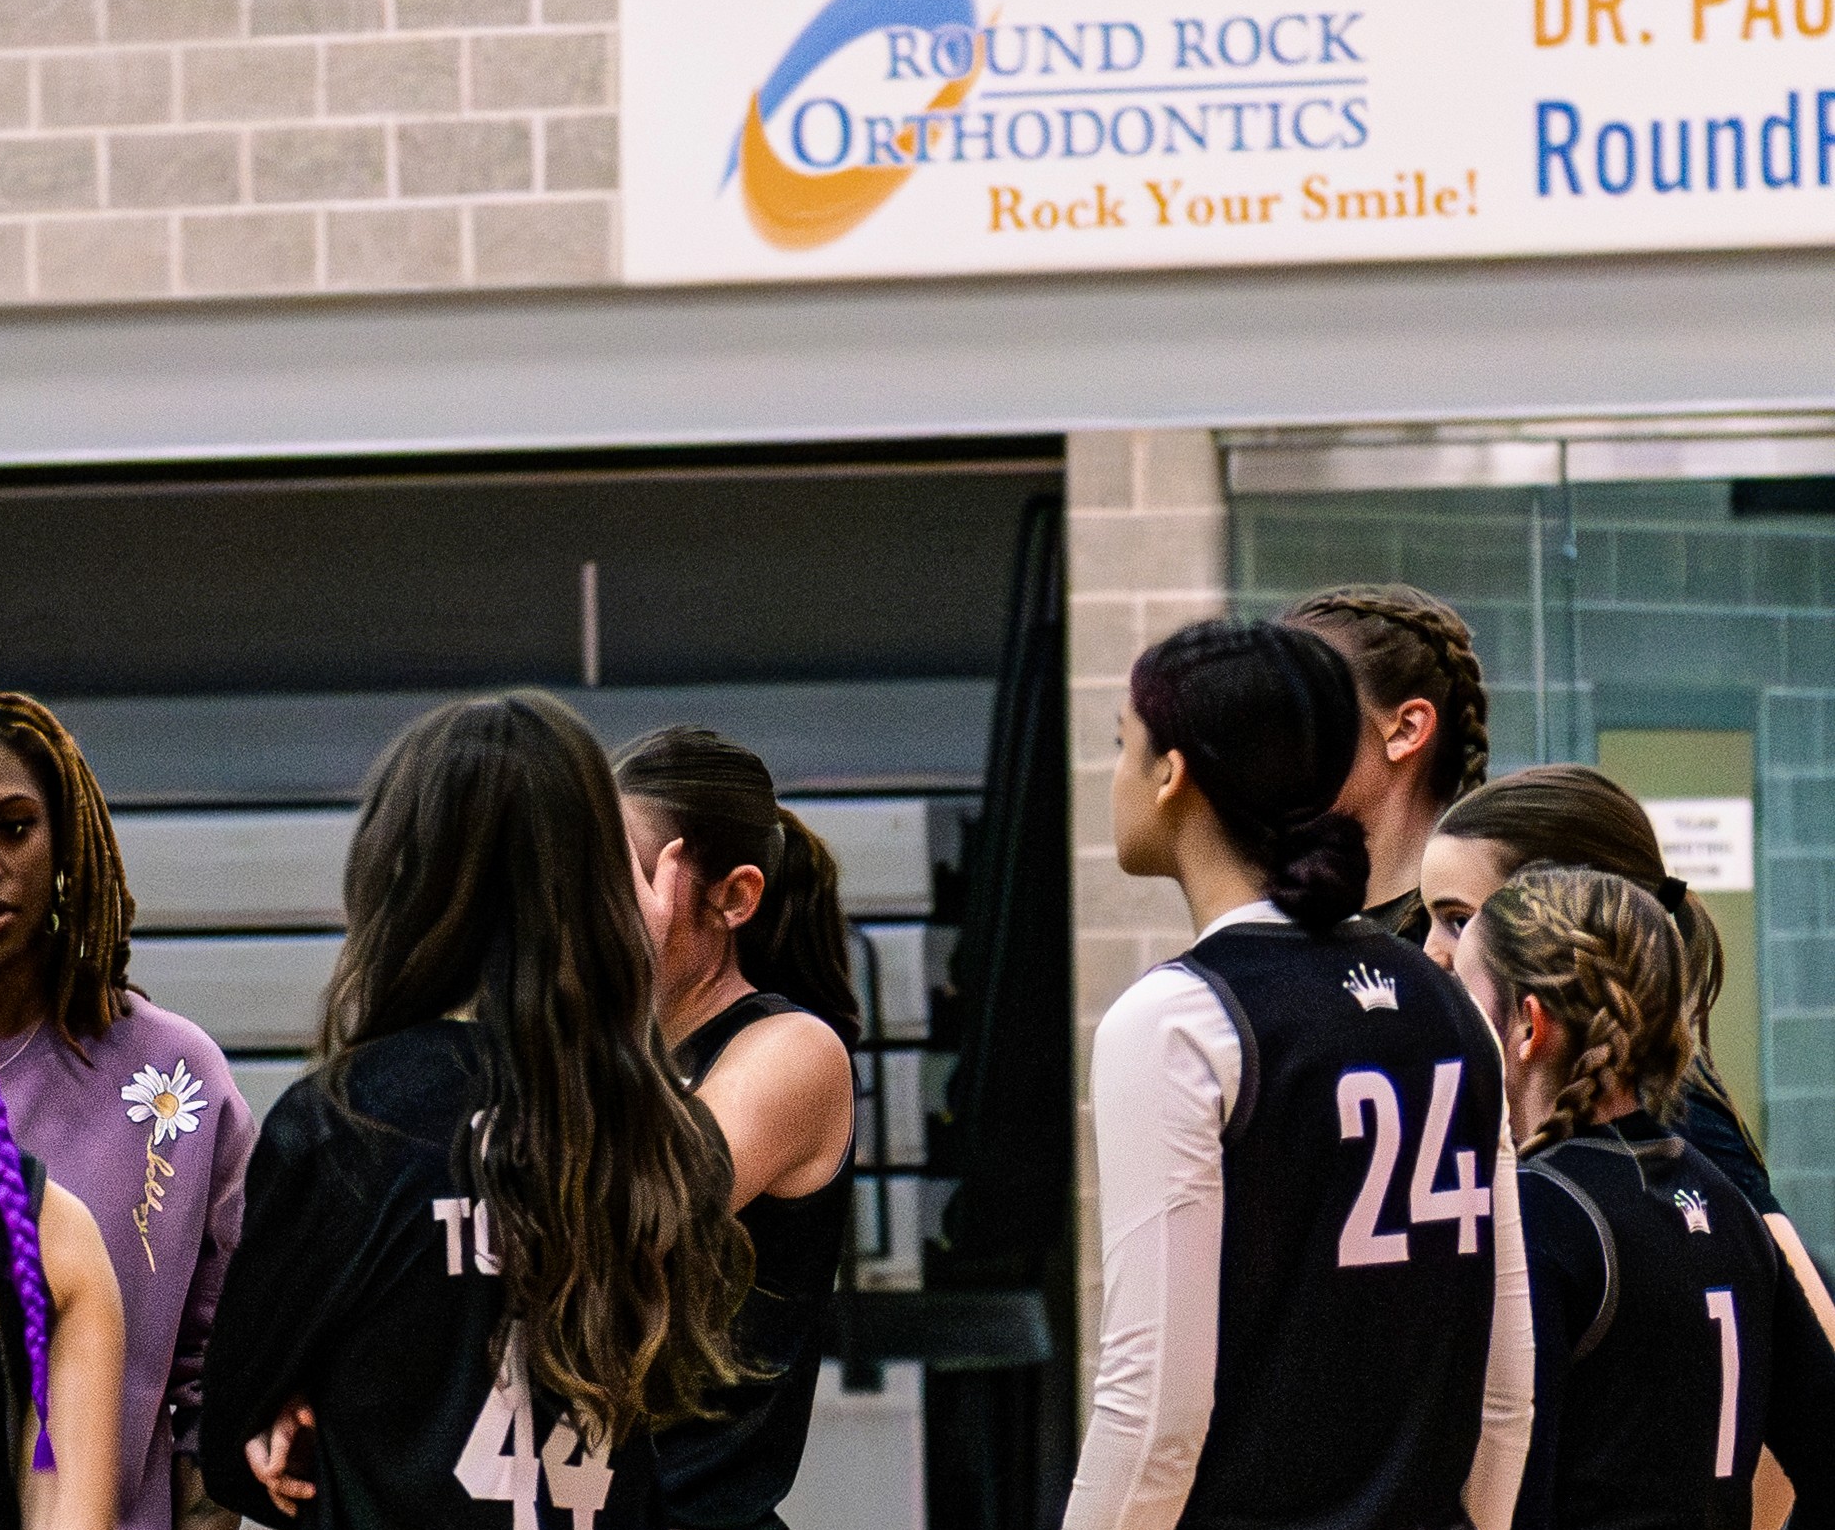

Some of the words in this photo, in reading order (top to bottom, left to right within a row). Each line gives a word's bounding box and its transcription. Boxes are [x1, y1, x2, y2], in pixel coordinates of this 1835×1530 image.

[882, 21, 1146, 80] ROUND
[1172, 12, 1365, 68] ROCK
[791, 96, 1369, 168] ORTHODONTICS
[988, 182, 1126, 233] Rock
[1144, 178, 1281, 226] Your
[1300, 168, 1478, 222] Smile!
[1336, 1061, 1490, 1267] 24
[1705, 1290, 1740, 1478] 1
